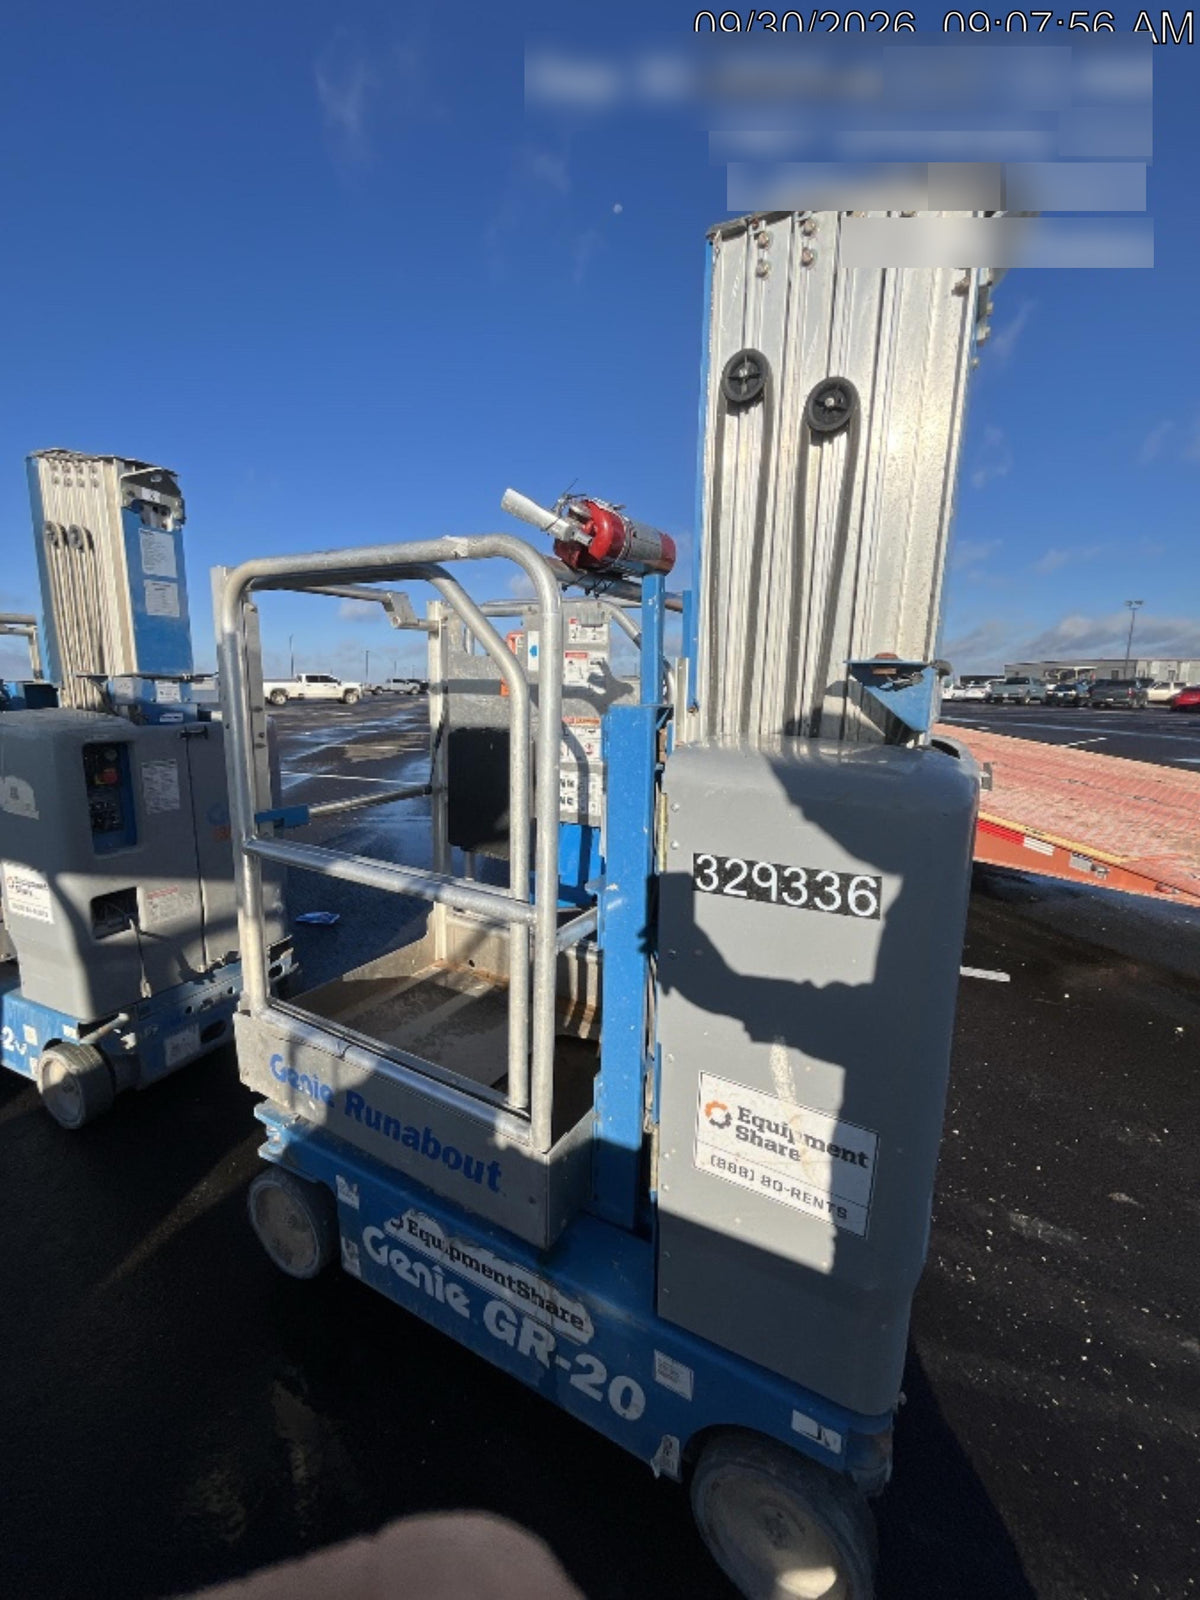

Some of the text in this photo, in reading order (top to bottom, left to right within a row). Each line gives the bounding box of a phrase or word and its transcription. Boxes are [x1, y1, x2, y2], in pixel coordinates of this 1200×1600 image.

[694, 853, 879, 918] 329336
[270, 1053, 504, 1193] Genie Runabout
[735, 1125, 801, 1162] Share
[710, 1154, 848, 1220] (888) 80-RENTS
[362, 1225, 647, 1421] Genie GR-20
